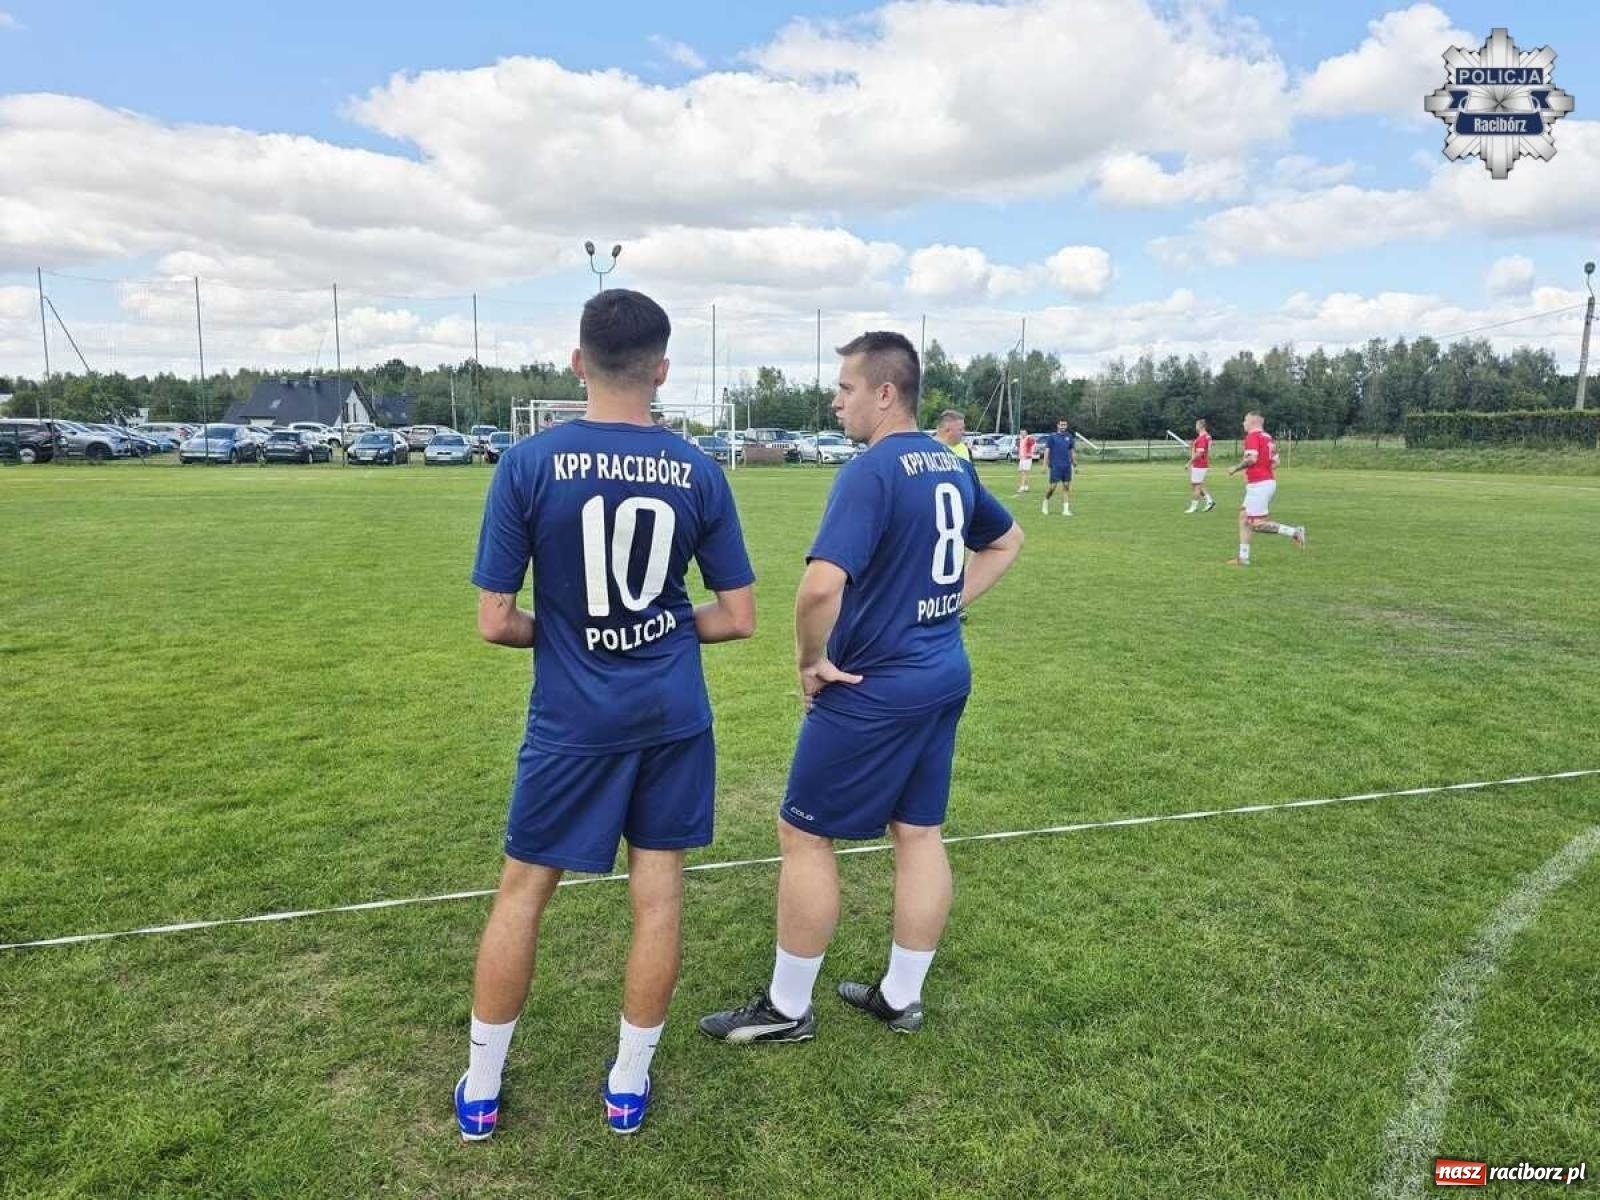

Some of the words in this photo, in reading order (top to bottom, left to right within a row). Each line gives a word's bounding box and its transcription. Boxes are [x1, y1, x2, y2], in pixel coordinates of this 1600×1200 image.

[554, 453, 592, 481] KPP
[596, 450, 692, 488] RACIBÓRZ
[900, 451, 924, 476] KPP
[931, 482, 965, 585] 8
[582, 495, 676, 617] 10
[917, 592, 962, 622] POLICJ
[585, 609, 677, 651] POLICJA
